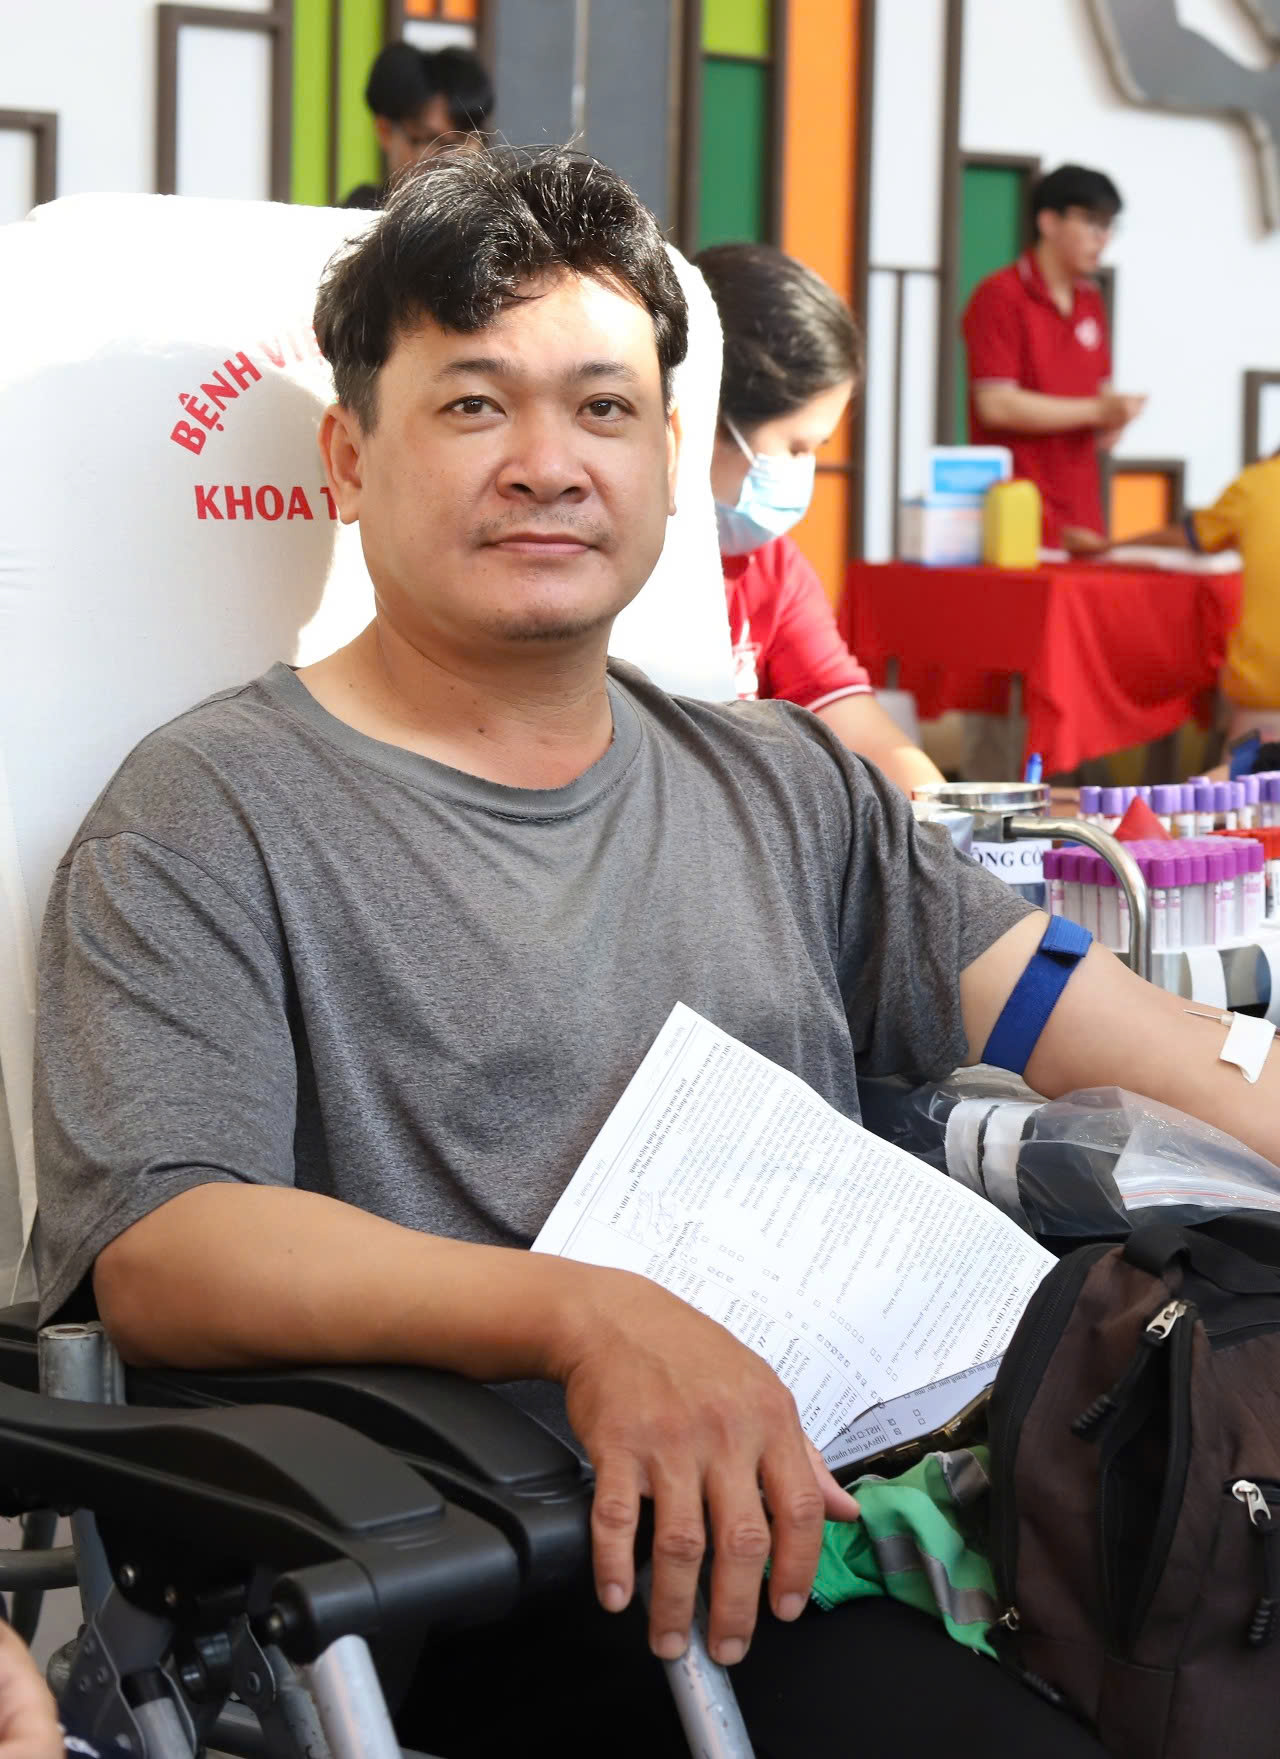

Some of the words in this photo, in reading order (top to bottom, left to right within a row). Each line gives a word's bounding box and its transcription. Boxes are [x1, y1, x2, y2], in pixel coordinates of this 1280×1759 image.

[170, 351, 262, 456] BỆNH
[194, 484, 314, 521] KHOA
[971, 847, 1014, 867] ÔNG
[993, 1306, 1008, 1324] CHO
